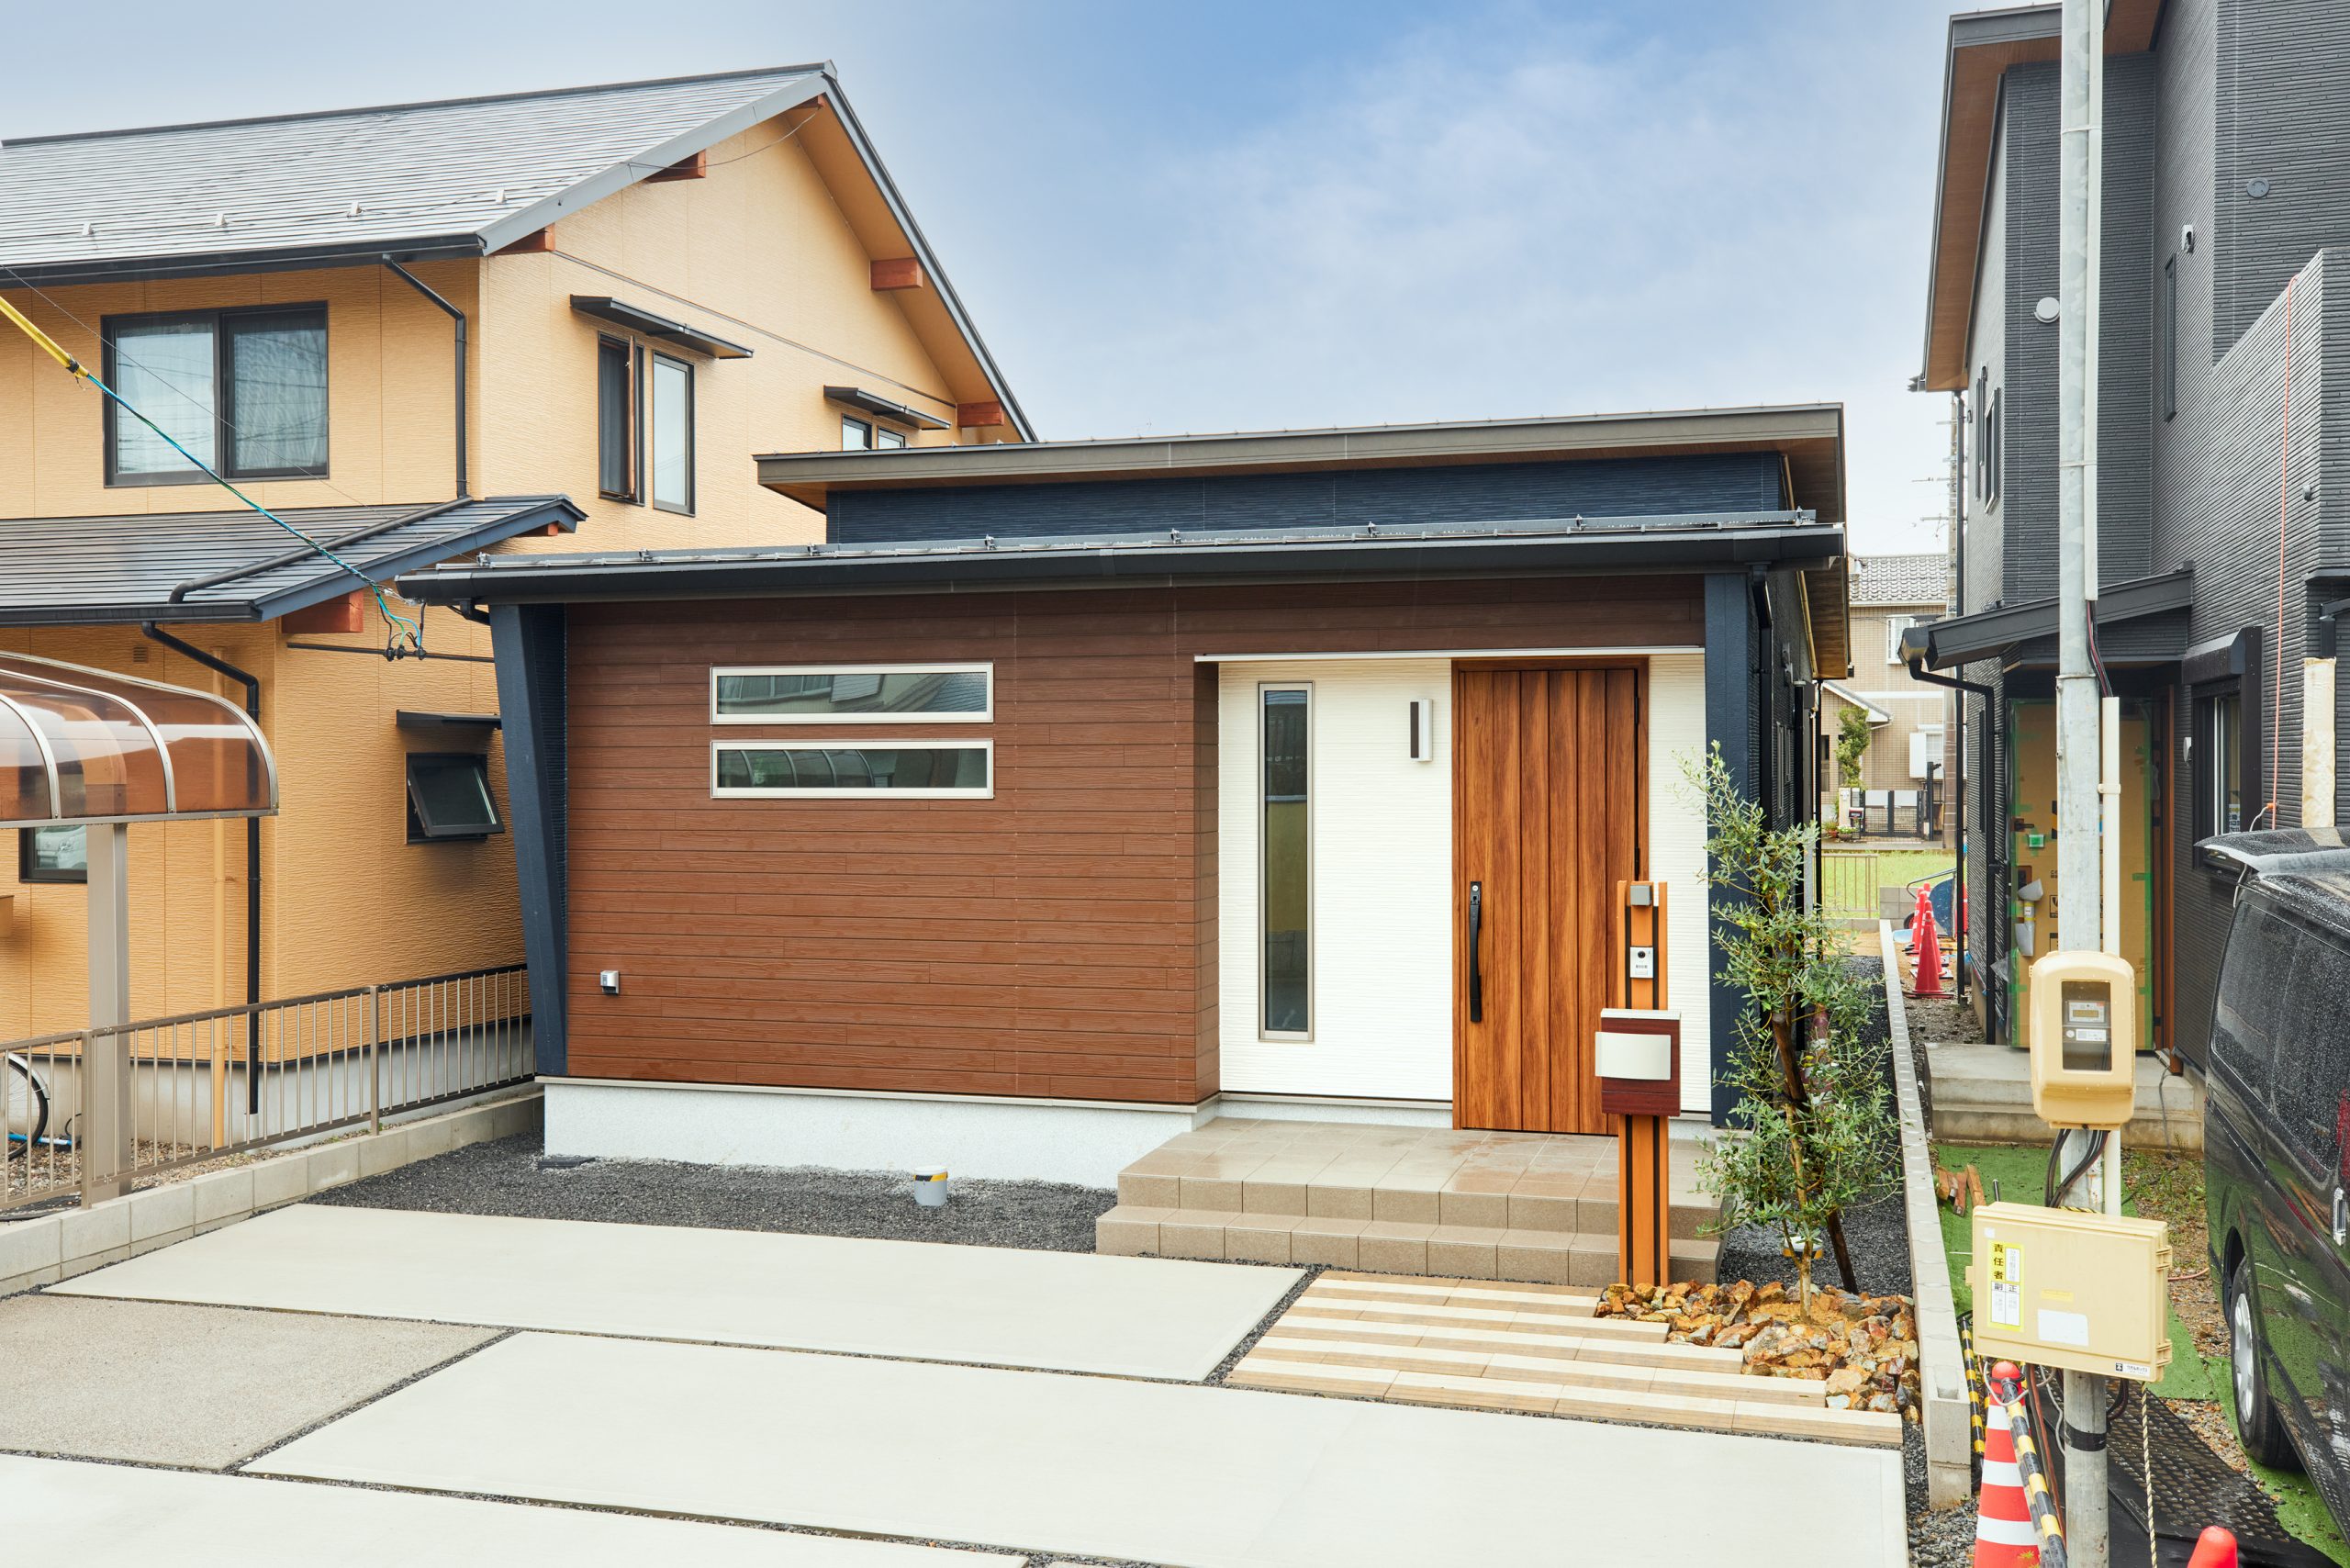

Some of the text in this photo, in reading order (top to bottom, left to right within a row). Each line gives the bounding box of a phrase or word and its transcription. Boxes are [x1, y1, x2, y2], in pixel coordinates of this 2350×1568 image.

[1994, 1244, 2003, 1280] 責任者
[2009, 1284, 2018, 1294] 正
